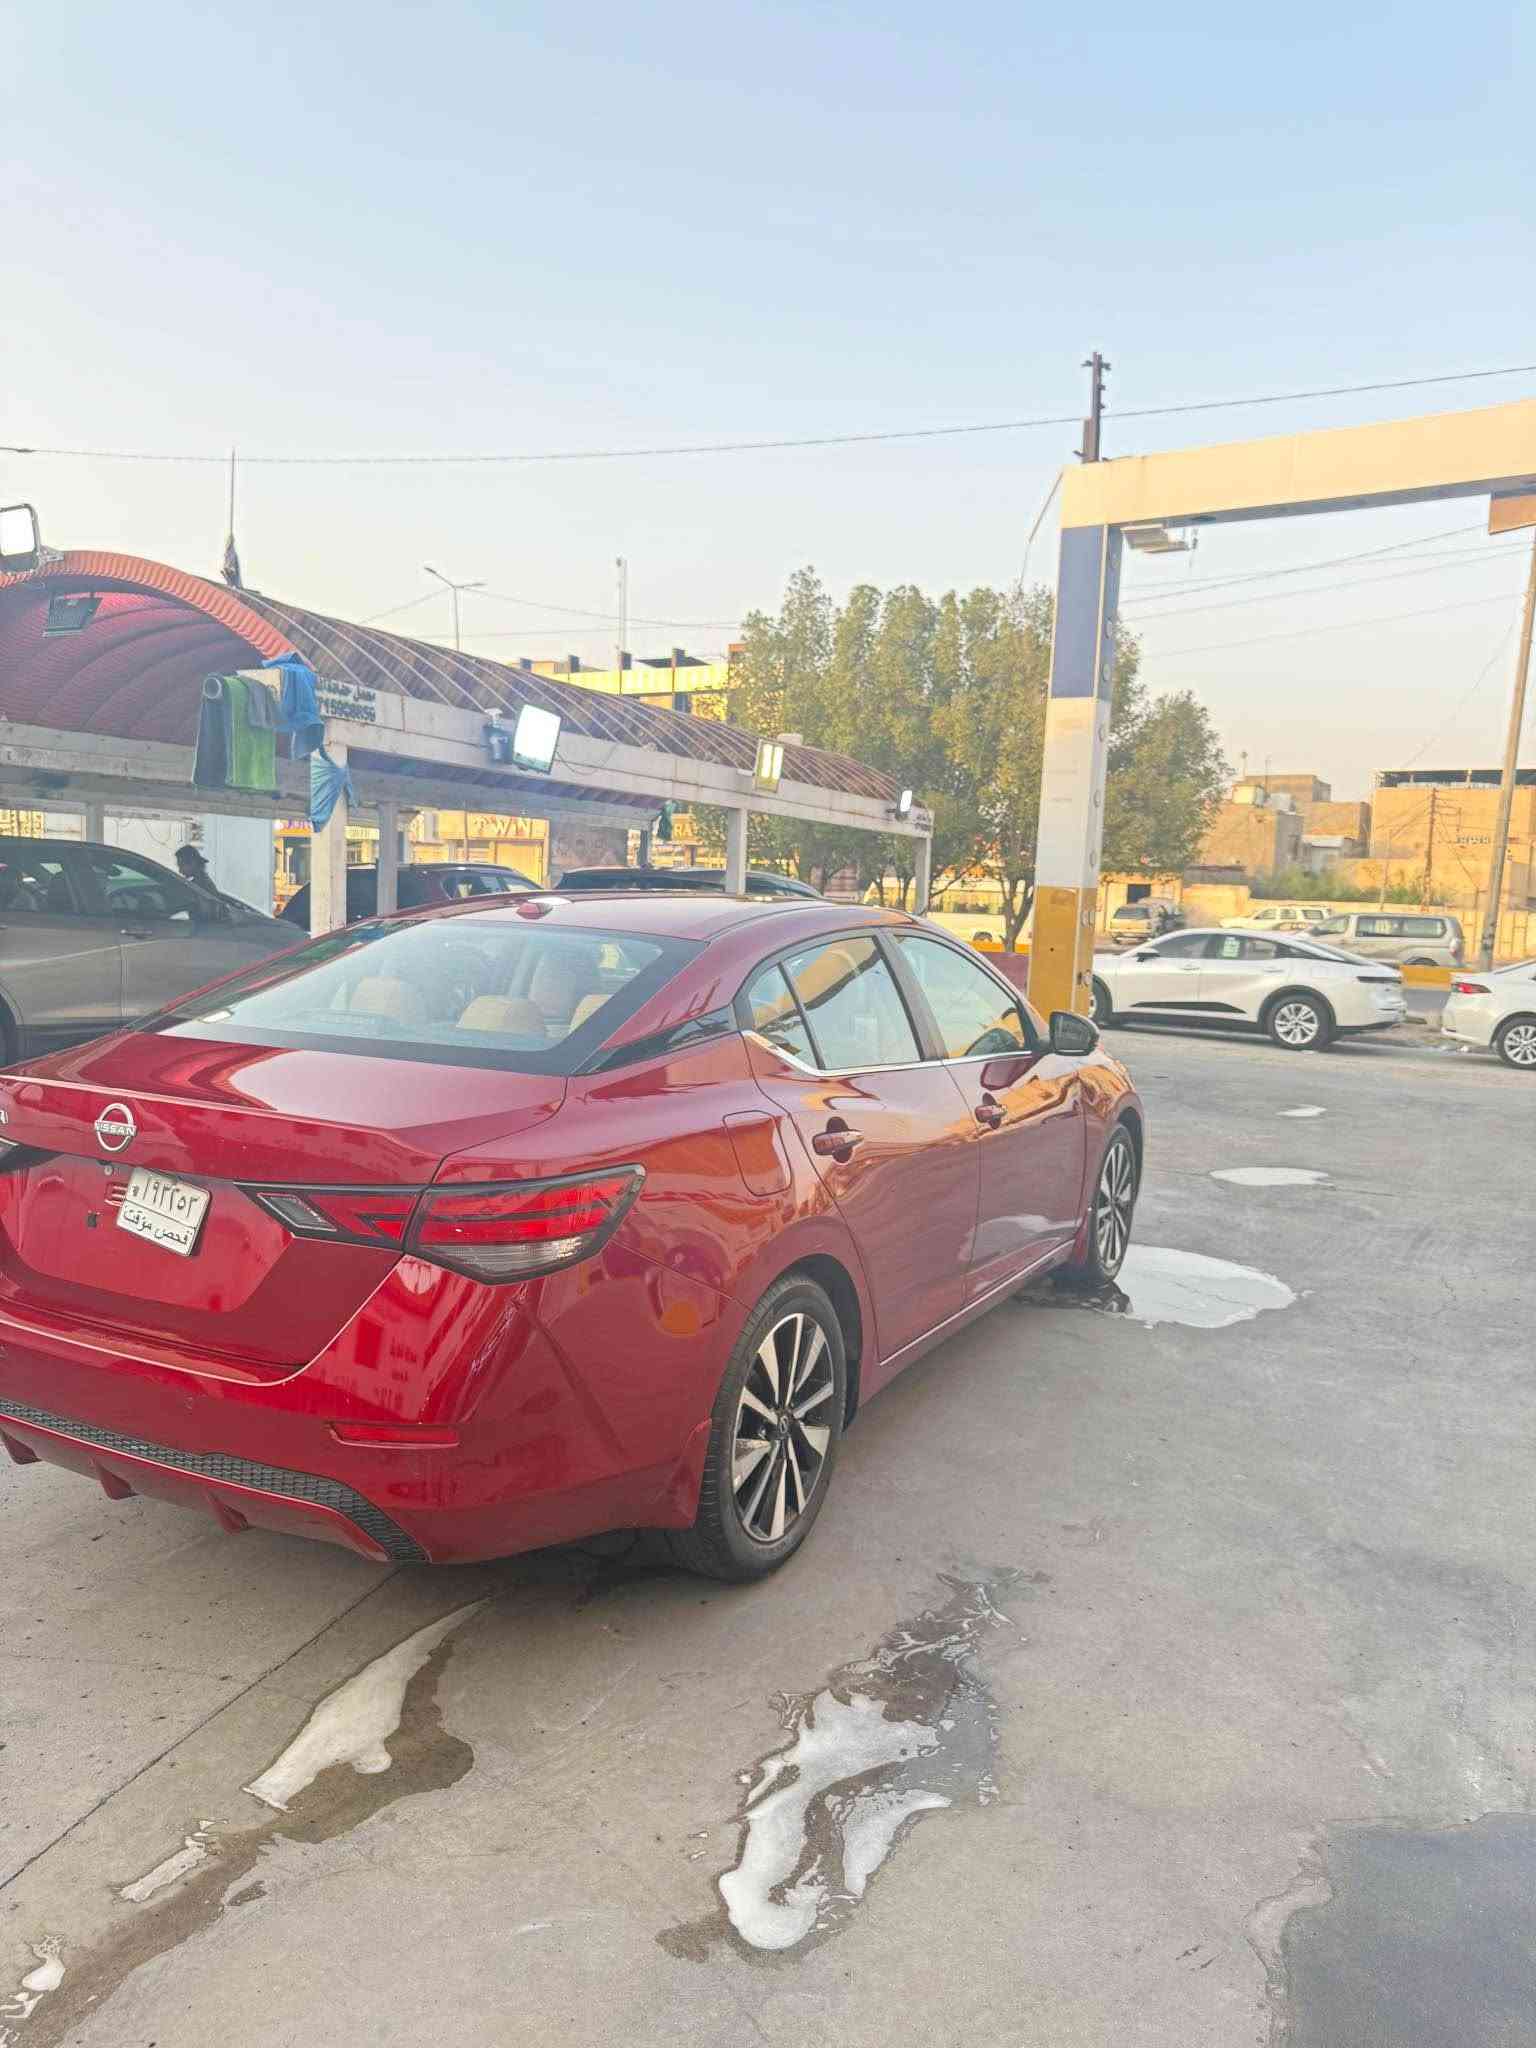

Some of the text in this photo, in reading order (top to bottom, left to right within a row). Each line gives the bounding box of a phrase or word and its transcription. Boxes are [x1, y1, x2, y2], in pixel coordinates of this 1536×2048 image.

[95, 1120, 137, 1137] NISSAN
[123, 1208, 193, 1245] فحص مؤقت
